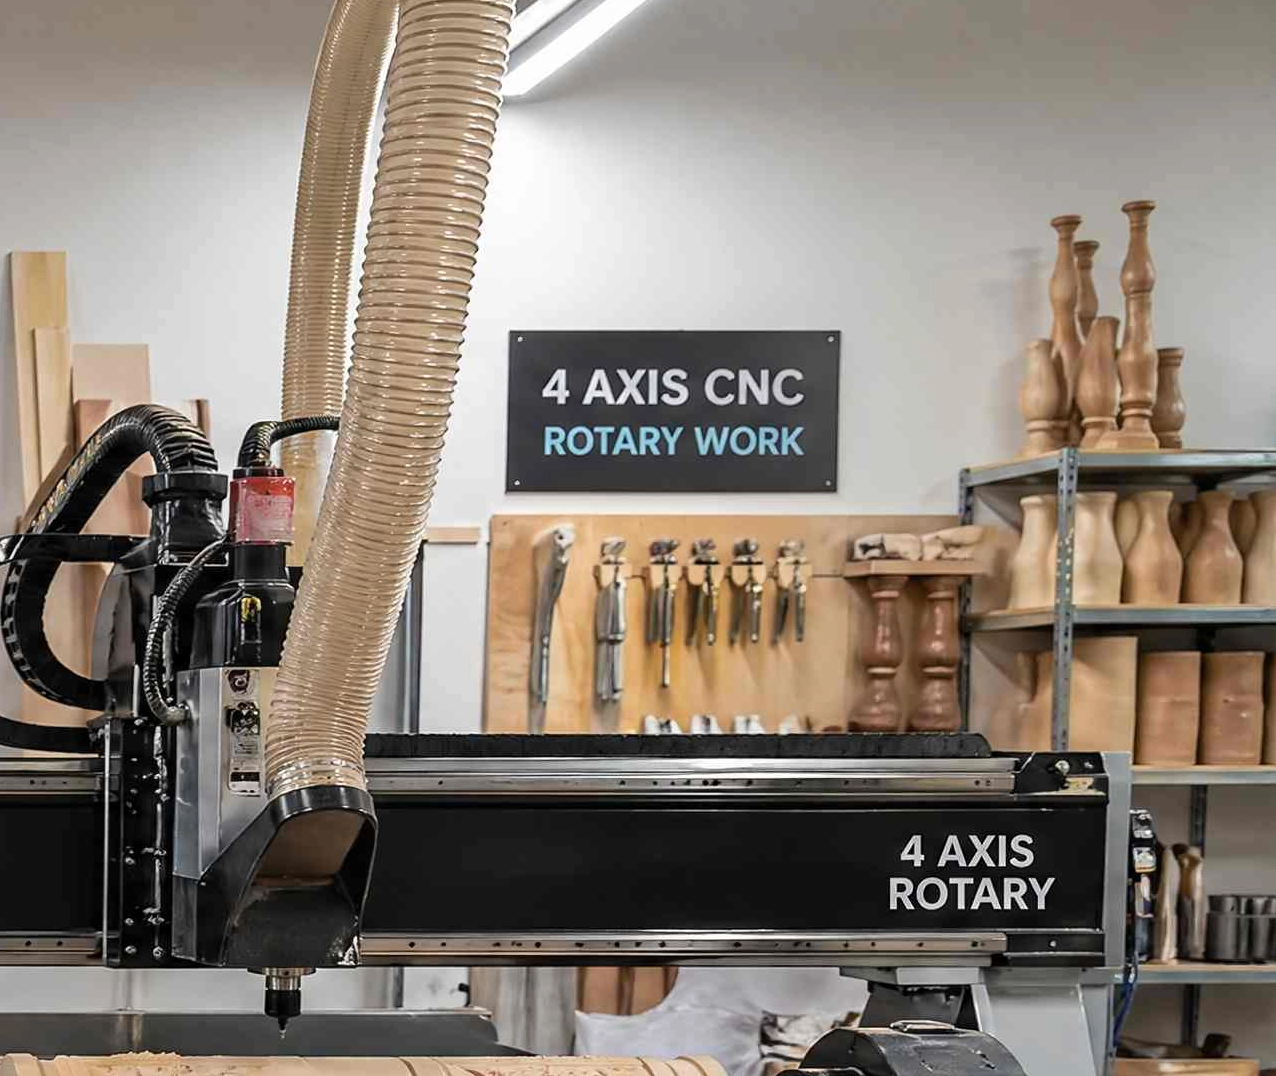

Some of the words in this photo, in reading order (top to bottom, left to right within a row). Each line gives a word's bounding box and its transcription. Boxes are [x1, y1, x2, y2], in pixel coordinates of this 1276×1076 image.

[542, 369, 570, 405] 4
[582, 368, 689, 406] AXIS
[704, 368, 804, 406] CNC
[544, 426, 683, 456] ROTARY
[694, 426, 804, 456] WORK
[900, 835, 925, 867] 4
[937, 834, 1034, 868] AXIS
[889, 877, 1055, 910] ROTARY
